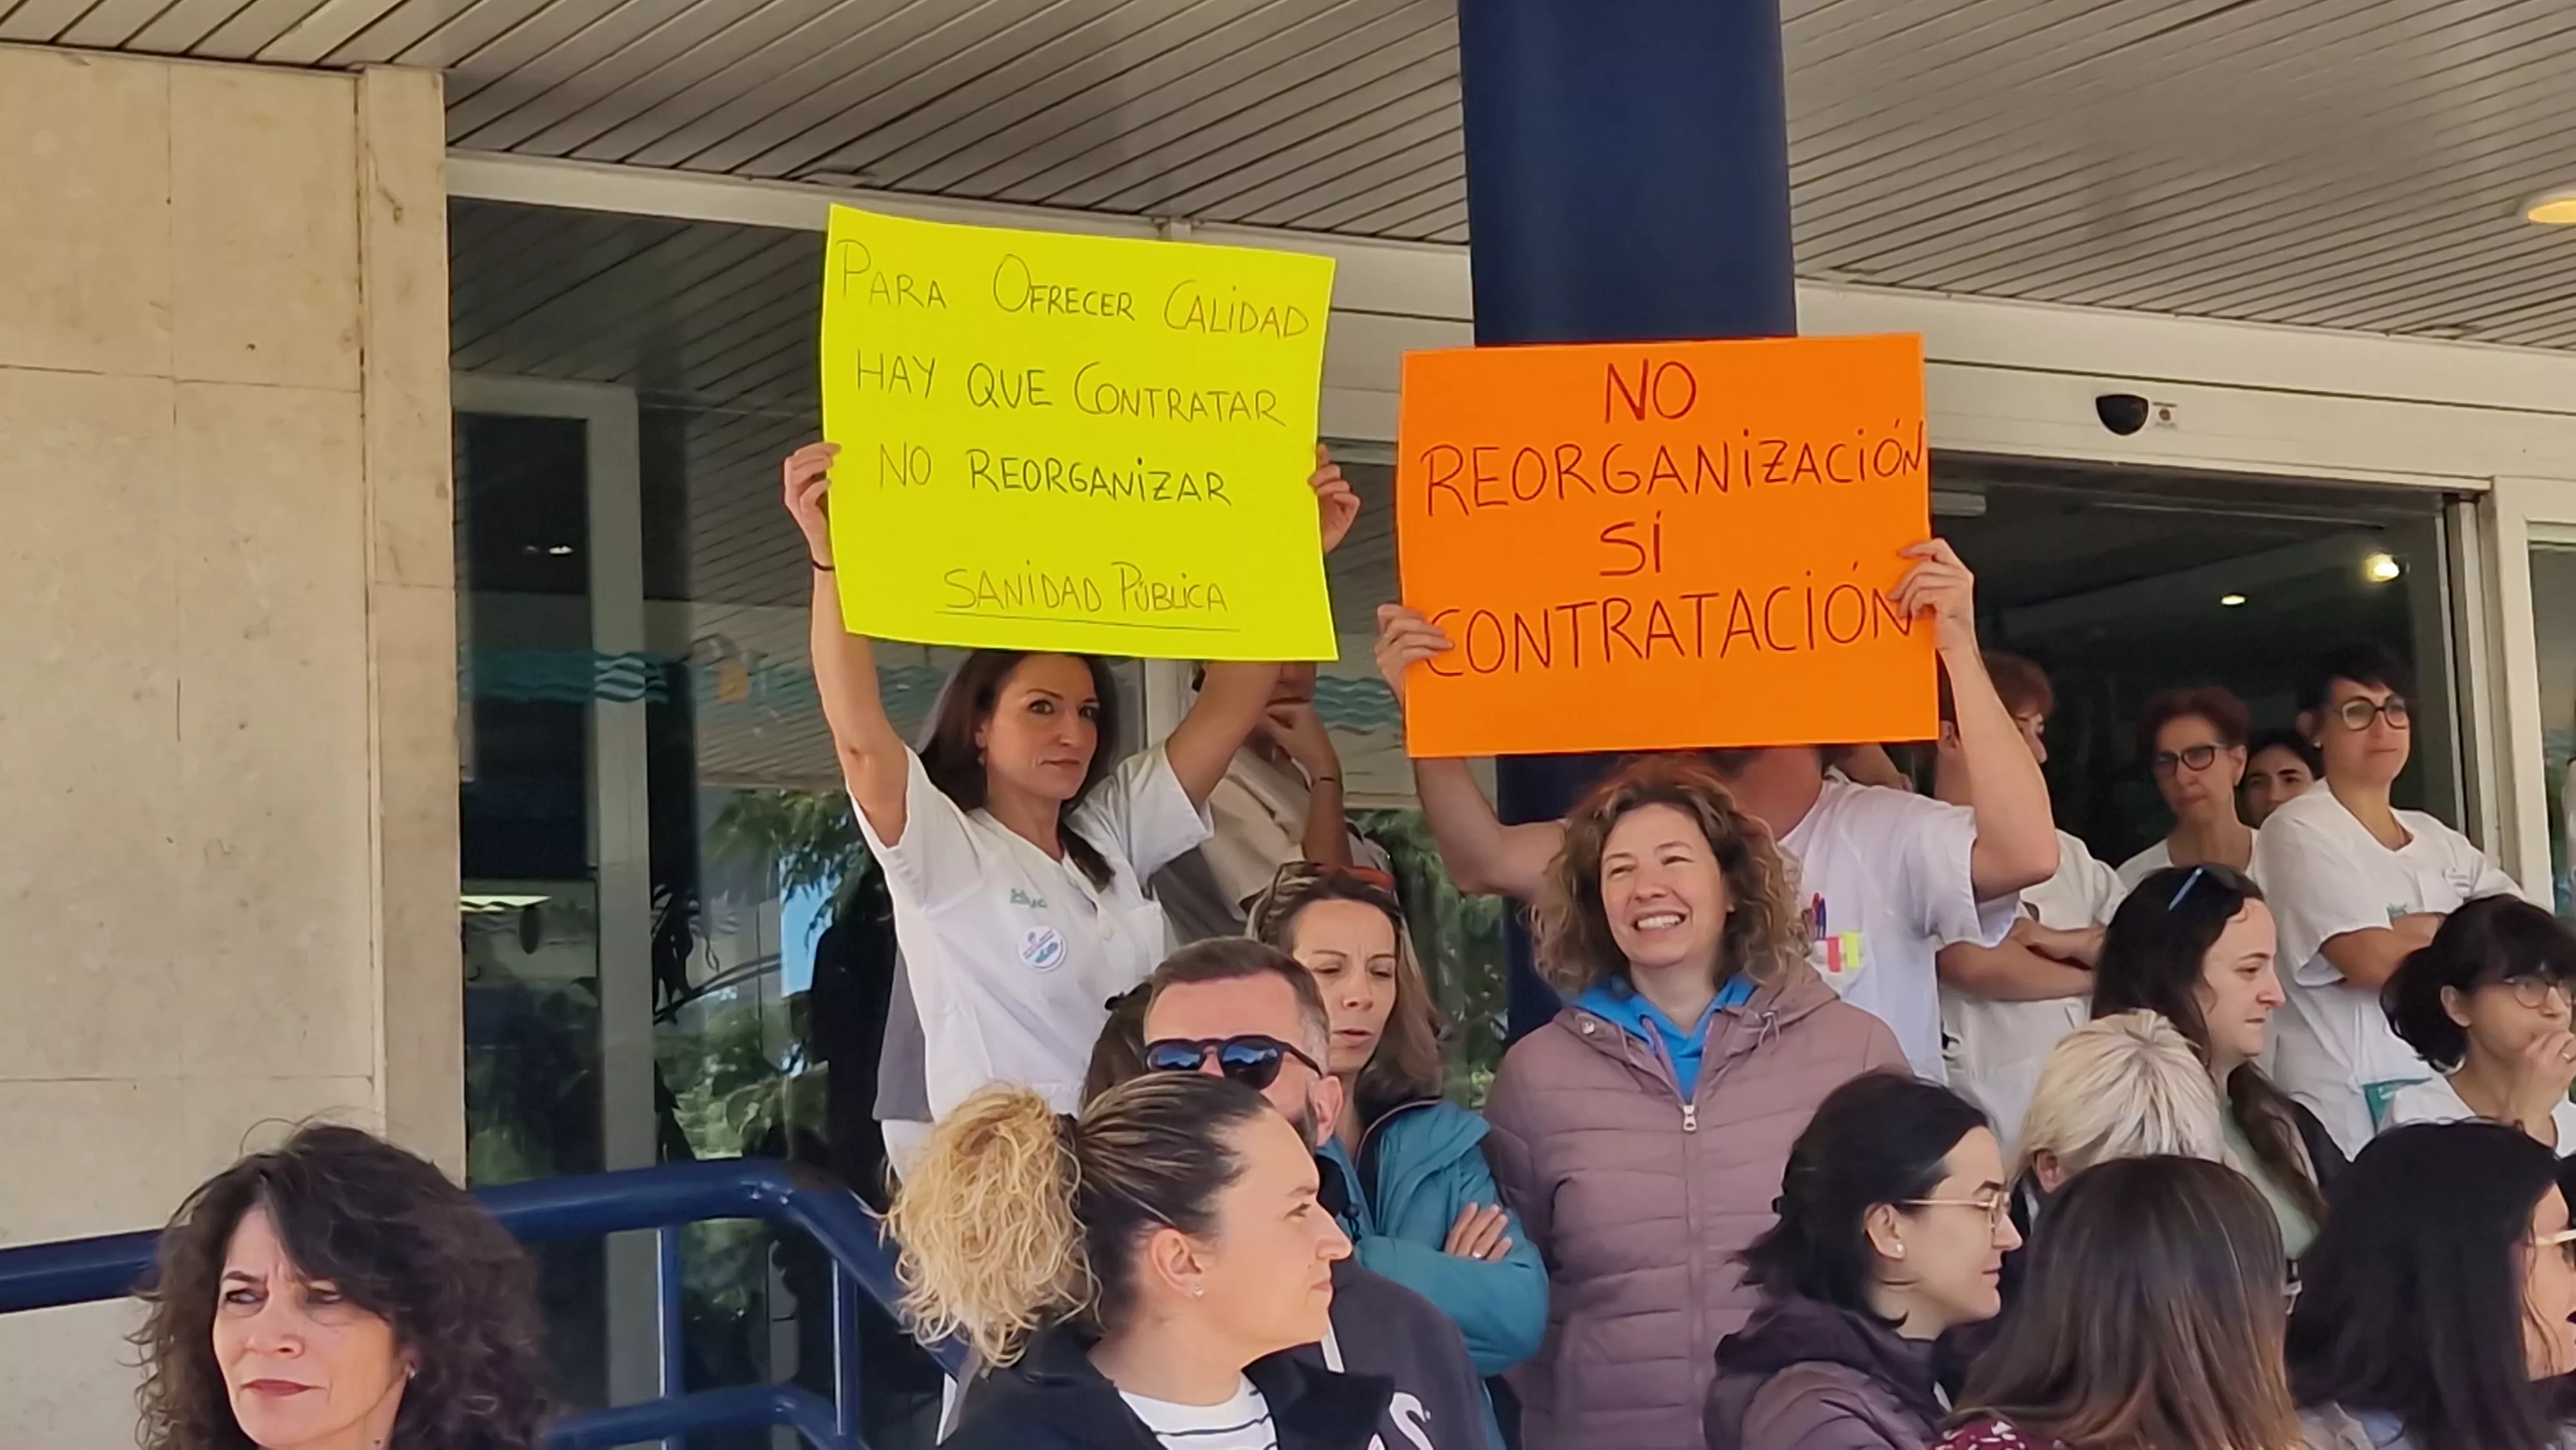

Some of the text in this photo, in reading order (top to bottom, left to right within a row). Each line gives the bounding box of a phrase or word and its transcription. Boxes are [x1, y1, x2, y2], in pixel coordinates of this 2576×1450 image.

[837, 239, 946, 309] PARA
[994, 254, 1135, 321] OFRECER
[858, 349, 1285, 427] HAY QUE CONTRATAR
[1604, 358, 1696, 424] NO
[880, 442, 931, 488] NO
[1600, 511, 1662, 577] SÍ
